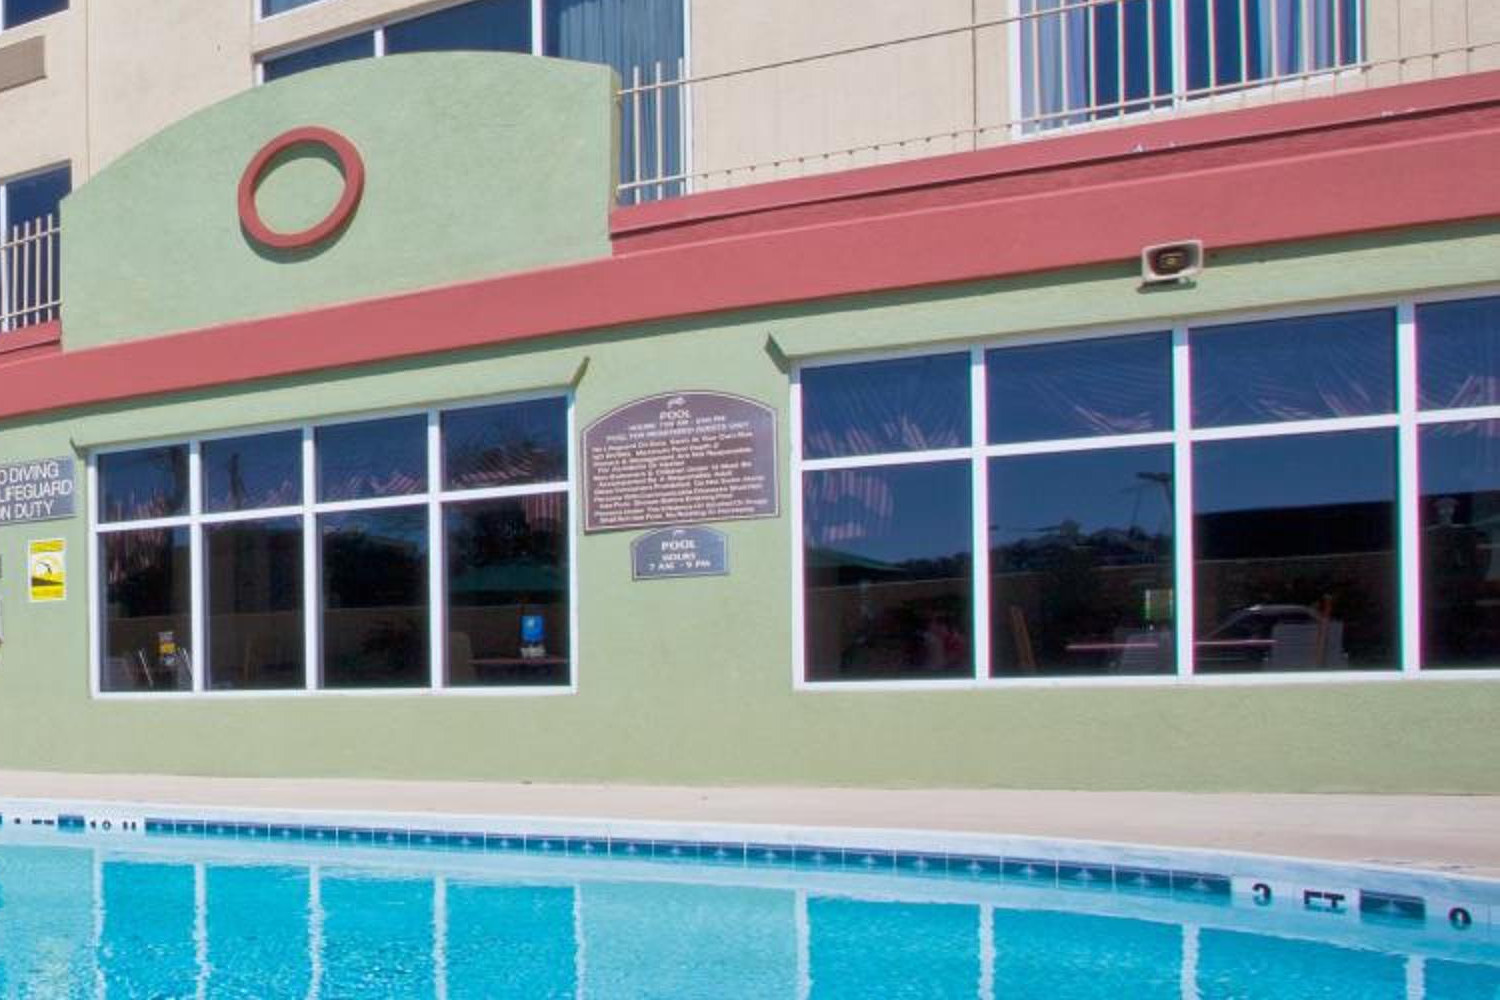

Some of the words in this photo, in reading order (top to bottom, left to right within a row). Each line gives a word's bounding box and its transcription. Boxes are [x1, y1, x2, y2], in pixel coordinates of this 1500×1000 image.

[9, 462, 60, 484] DIVING
[14, 501, 54, 519] DUTY
[661, 539, 696, 550] POOL
